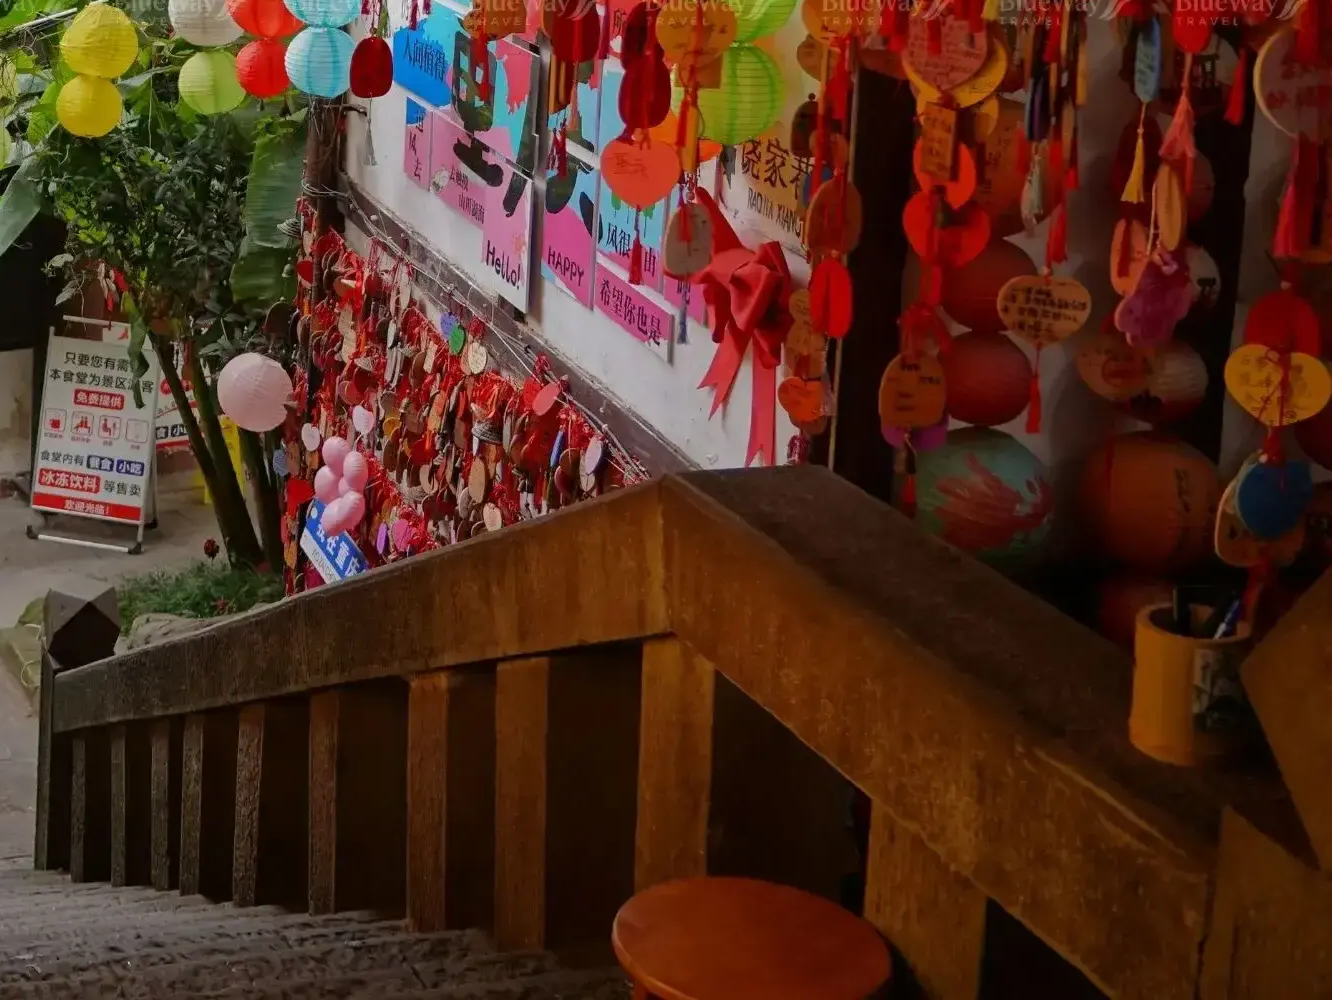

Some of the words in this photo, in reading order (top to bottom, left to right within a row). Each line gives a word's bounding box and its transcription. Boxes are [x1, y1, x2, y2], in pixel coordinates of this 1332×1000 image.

[403, 32, 446, 83] 人间值得
[486, 239, 522, 291] Hello!
[548, 248, 585, 288] HAPPY
[606, 222, 657, 277] 风很由
[599, 279, 662, 346] 希望你也是
[64, 351, 134, 374] 只要您有需
[76, 392, 124, 409] 免费提供
[41, 450, 85, 467] 食堂内有
[118, 460, 144, 474] 小吃
[41, 470, 99, 491] 冰冻饮料
[103, 479, 142, 497] 等售卖
